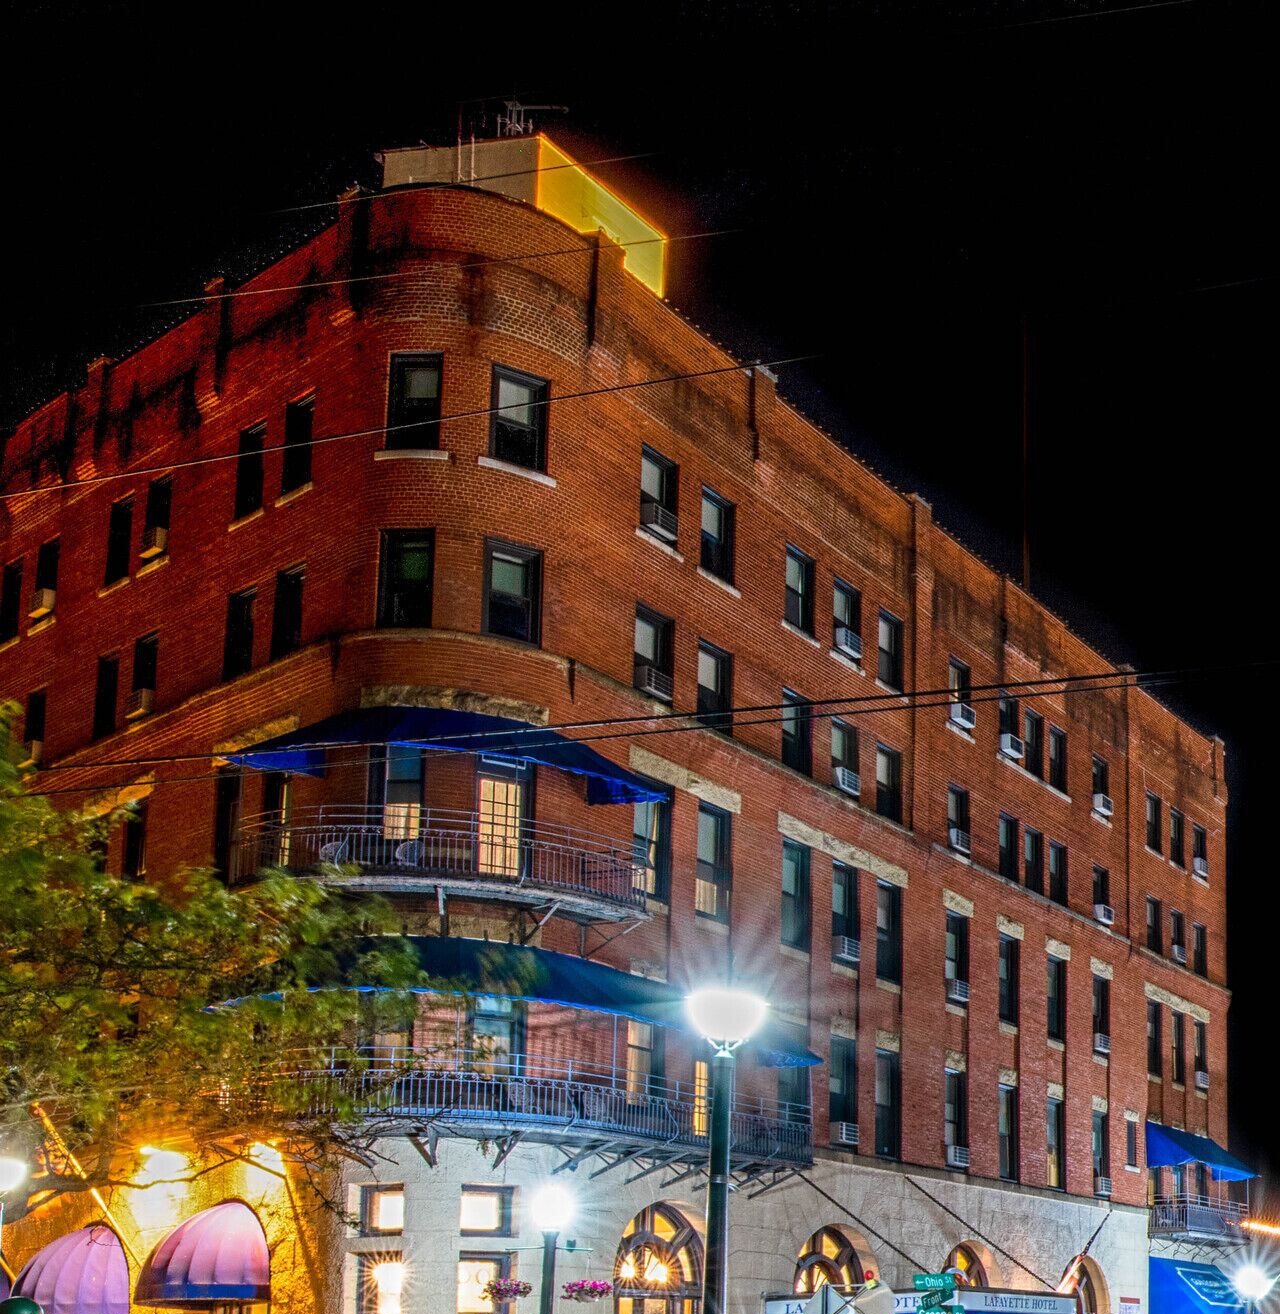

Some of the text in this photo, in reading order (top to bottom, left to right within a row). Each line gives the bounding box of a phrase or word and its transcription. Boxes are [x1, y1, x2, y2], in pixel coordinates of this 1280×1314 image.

[925, 1275, 953, 1287] Ohio St
[922, 1292, 943, 1308] Front
[984, 1295, 1058, 1311] LAFAYETTE HOTEL
